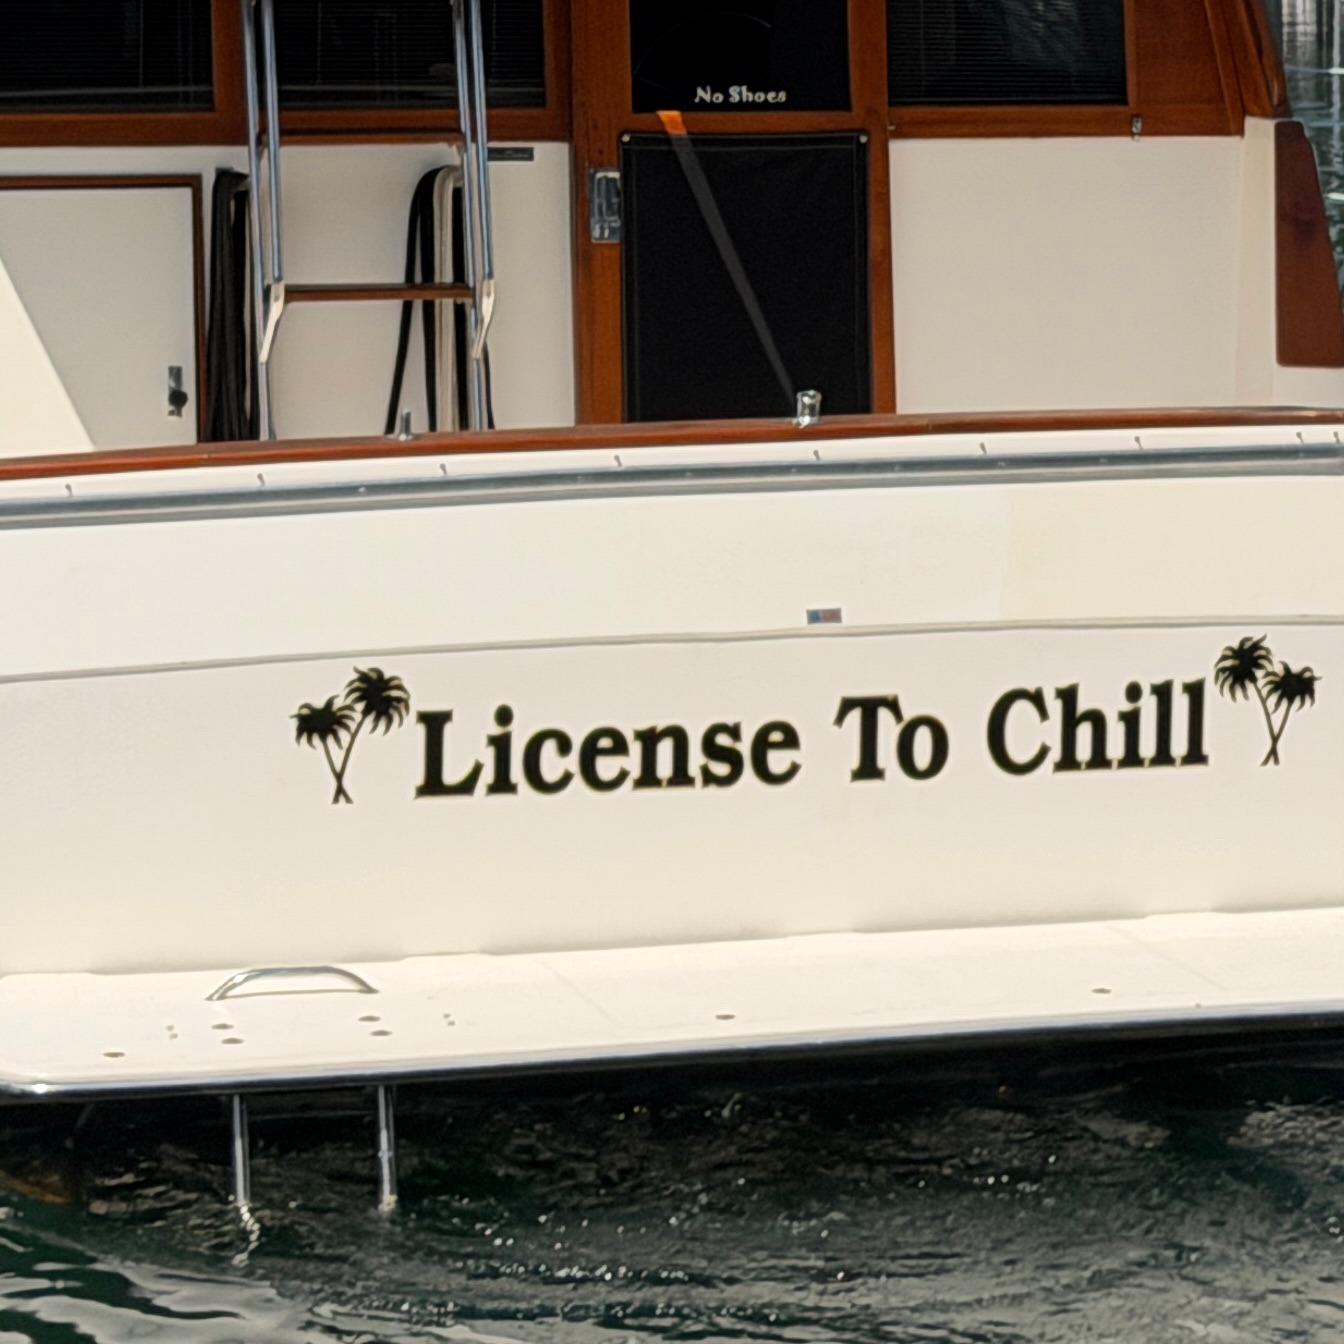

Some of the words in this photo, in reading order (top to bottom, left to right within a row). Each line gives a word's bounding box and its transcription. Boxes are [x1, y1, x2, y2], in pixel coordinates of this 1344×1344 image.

[694, 85, 724, 103] No
[728, 85, 787, 103] Shoes
[416, 704, 801, 800] License
[834, 695, 949, 783] To
[986, 678, 1209, 777] Chill
